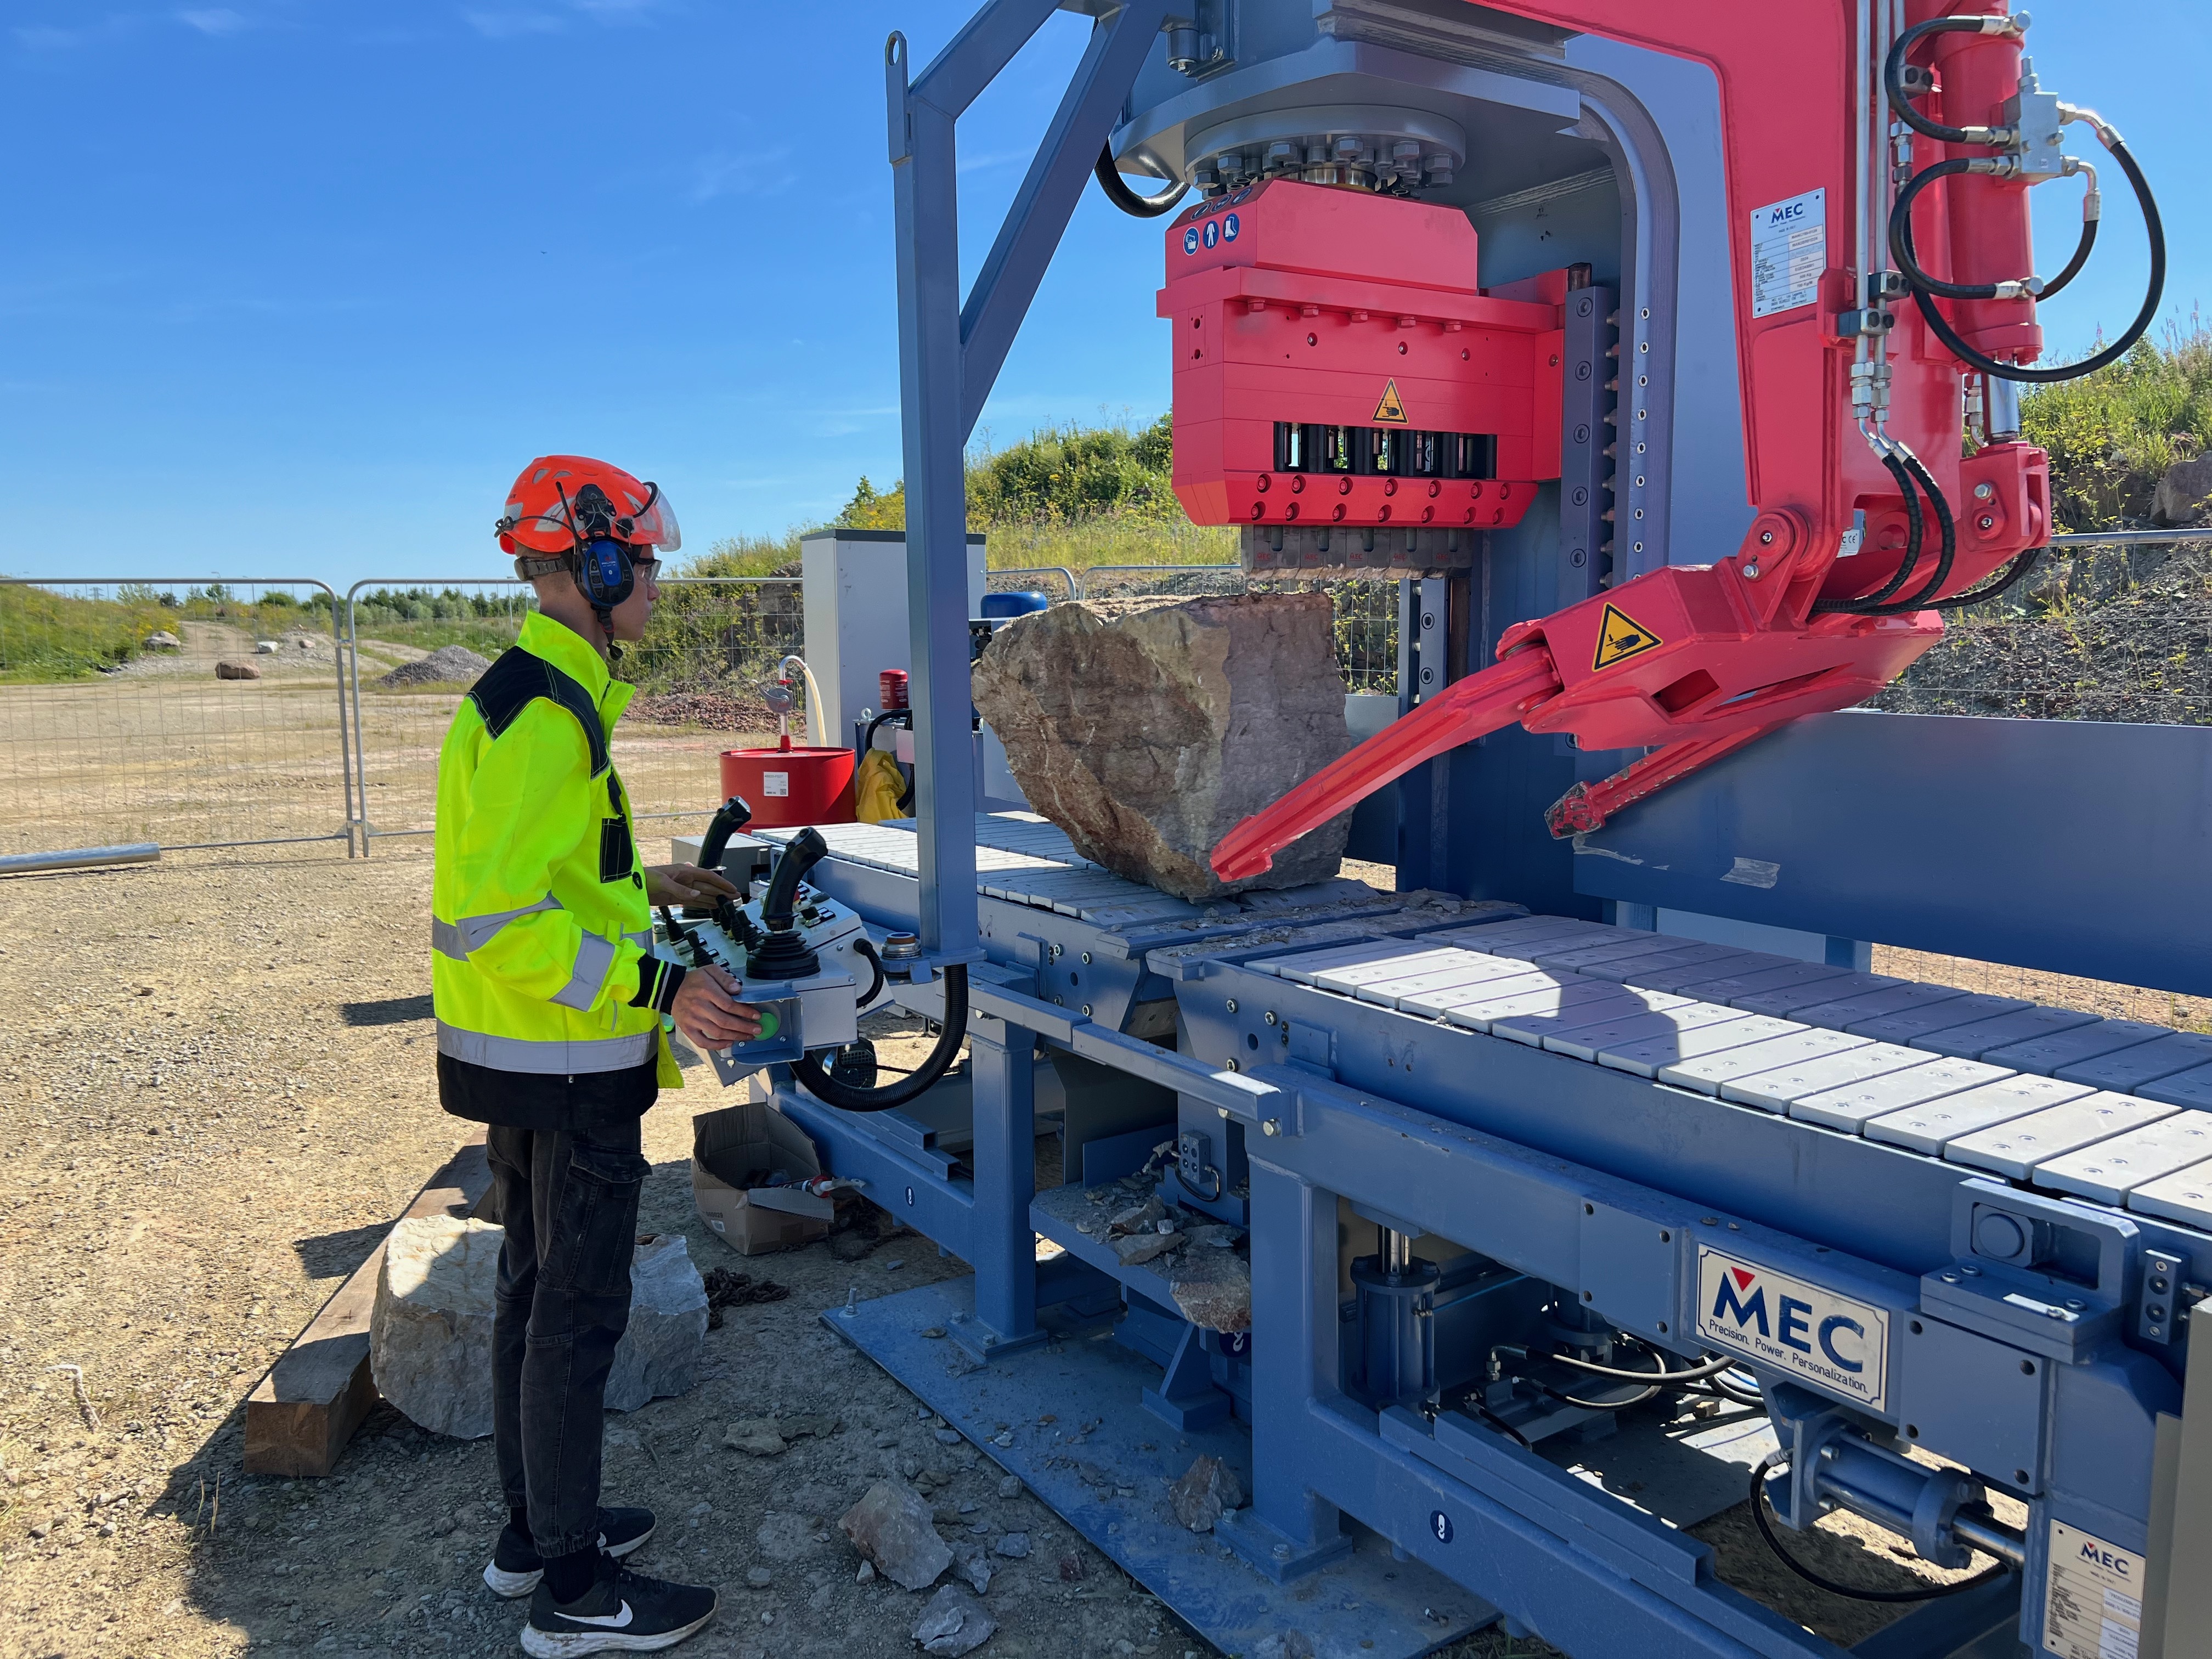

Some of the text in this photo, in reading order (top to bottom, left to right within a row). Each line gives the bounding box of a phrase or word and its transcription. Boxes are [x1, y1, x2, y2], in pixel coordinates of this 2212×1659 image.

[1771, 203, 1803, 223] MEC
[1712, 1267, 1864, 1373] MEC
[1709, 1319, 1868, 1393] Precision. Power. Personalization.
[2080, 1542, 2129, 1575] MEC
